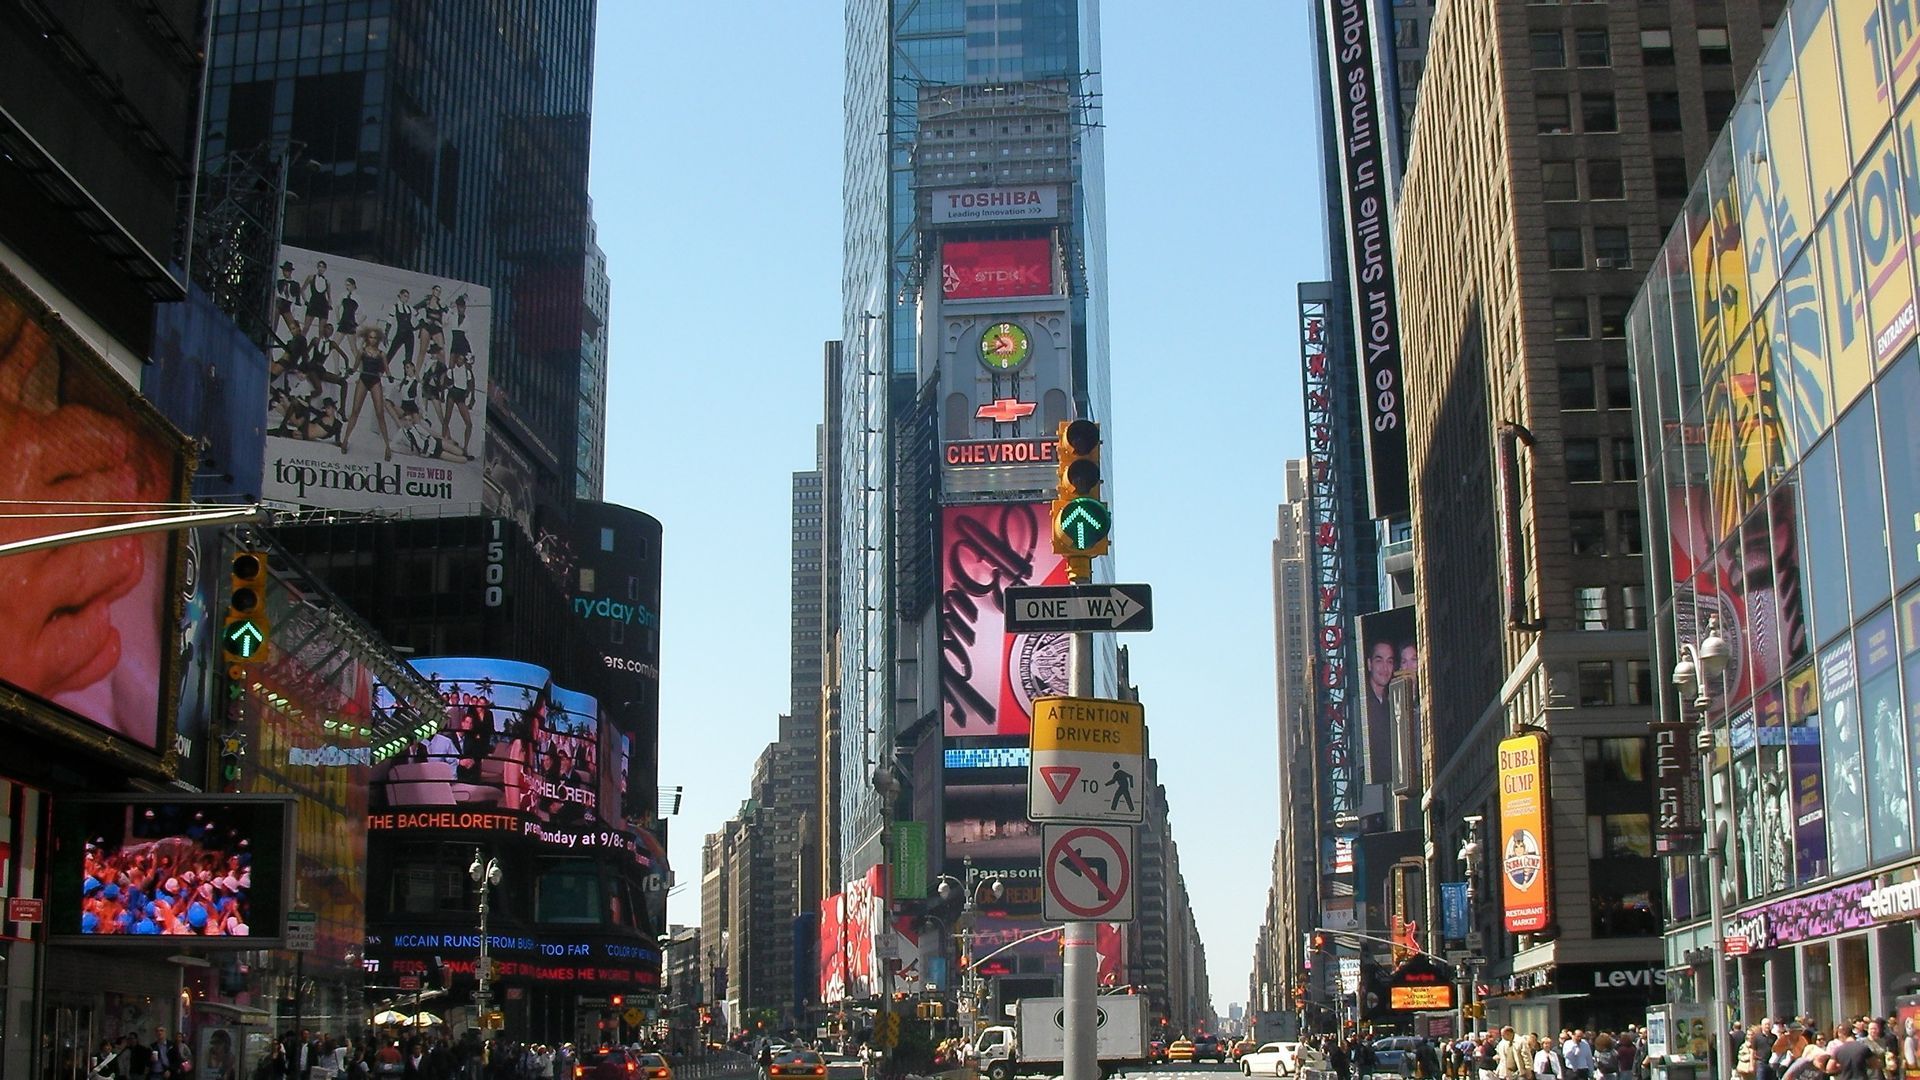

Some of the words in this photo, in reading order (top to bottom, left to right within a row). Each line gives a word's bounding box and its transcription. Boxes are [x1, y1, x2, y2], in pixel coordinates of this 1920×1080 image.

[1863, 0, 1920, 90] TH
[1350, 67, 1372, 157] Times
[1355, 158, 1375, 191] in
[948, 191, 1041, 208] TOSHIBA
[948, 209, 981, 218] Leading
[982, 208, 1025, 216] Innovation
[1358, 196, 1383, 282] Smile
[1000, 323, 1010, 334] 12
[1369, 290, 1390, 365] Your
[1876, 302, 1915, 356] ENTRANCE
[1021, 339, 1027, 350] 3
[1001, 358, 1008, 369] 6
[1374, 368, 1396, 432] See
[290, 458, 341, 470] AMERICA'S
[344, 464, 370, 472] NEXT
[274, 458, 318, 499] top
[319, 462, 403, 496] model
[426, 467, 446, 481] WED
[447, 470, 453, 481] 8
[485, 520, 504, 607] 1500
[1027, 600, 1068, 618] ONE
[1087, 599, 1130, 617] WAY
[1048, 707, 1129, 724] ATTENTION
[1056, 726, 1121, 744] DRIVERS
[1500, 749, 1536, 771] BUBBA
[1081, 779, 1099, 794] TO
[1504, 773, 1534, 794] GUMP
[367, 815, 394, 829] THE
[398, 813, 518, 831] BACHELORETTE
[582, 834, 596, 845] at
[601, 832, 624, 848] 9/8c
[1505, 857, 1523, 872] BUBBA
[1523, 856, 1540, 870] GUMP
[969, 867, 1042, 879] Panasoni
[1505, 906, 1543, 918] RESTAURANT
[1512, 918, 1537, 927] MARKET
[395, 935, 439, 948] MCCAIN
[444, 935, 480, 948] RUNS
[485, 936, 515, 949] FROM
[568, 944, 590, 956] FAR
[577, 967, 595, 980] HE
